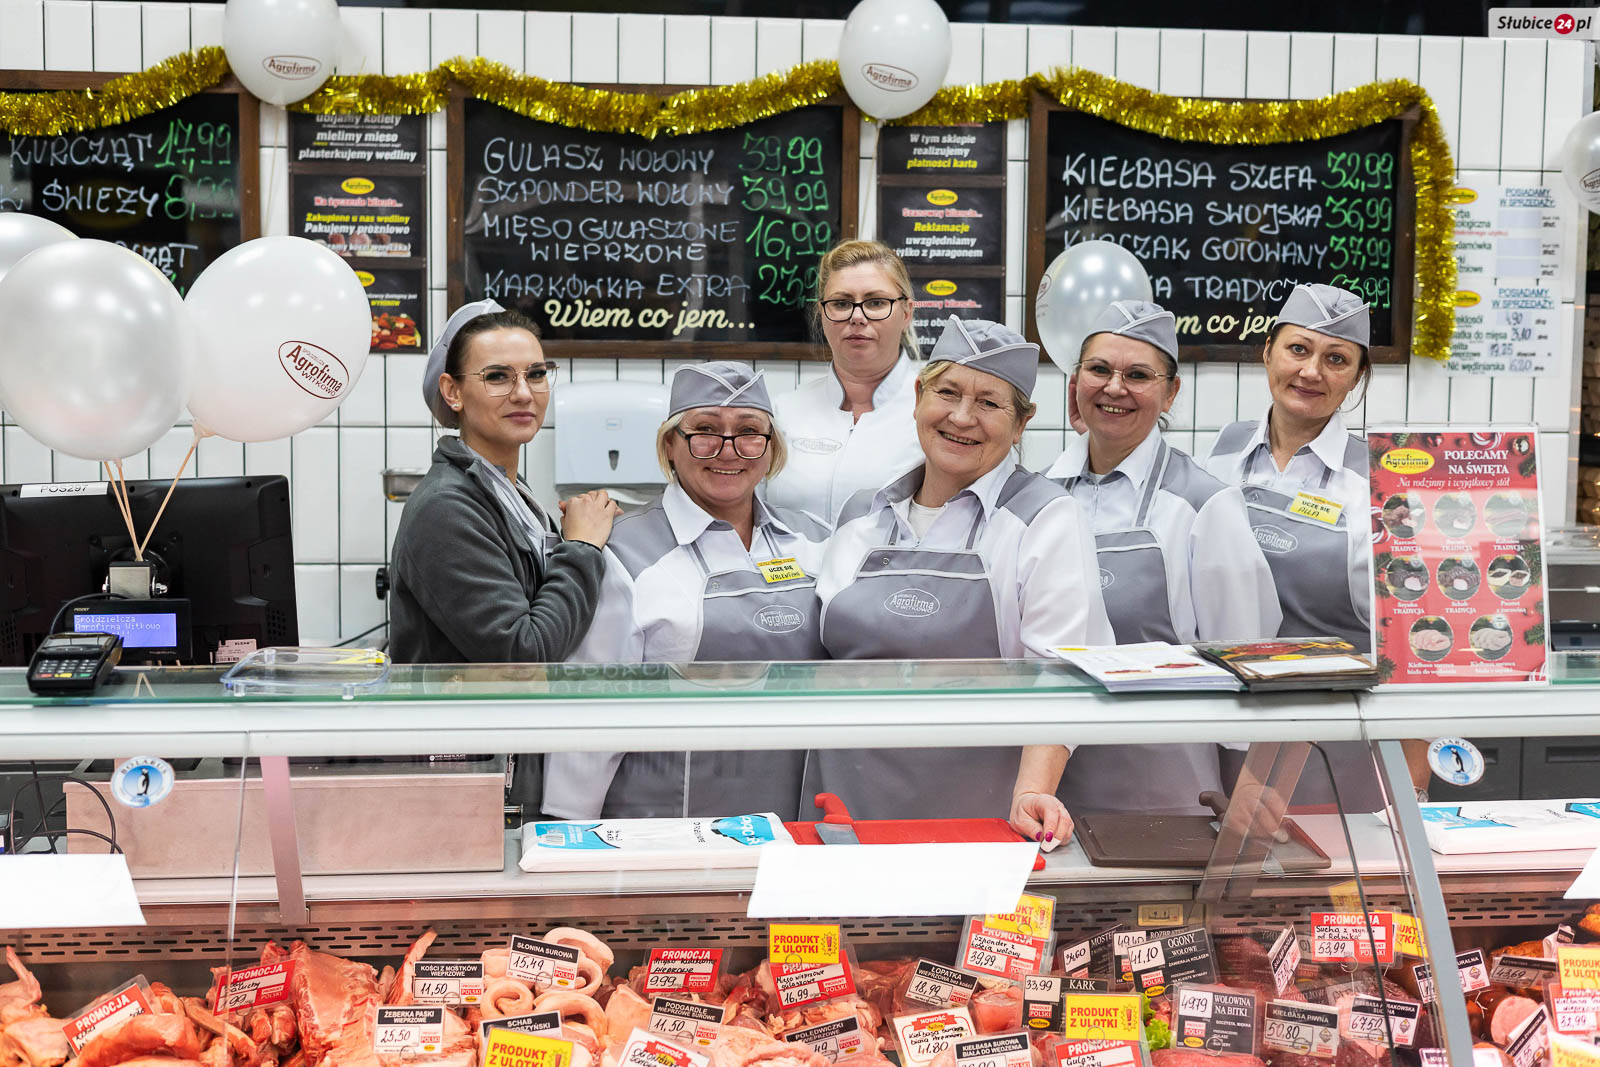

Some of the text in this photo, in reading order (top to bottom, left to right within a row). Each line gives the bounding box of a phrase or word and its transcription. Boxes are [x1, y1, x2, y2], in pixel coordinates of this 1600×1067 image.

[268, 57, 316, 74] Agrofirma
[867, 65, 912, 87] Agrofirma
[317, 131, 362, 143] mielimy
[921, 135, 939, 144] tym
[10, 119, 231, 173] KURCZĄT 17,99
[913, 146, 970, 157] realizujemy
[299, 148, 373, 161] plasterkujemy
[484, 132, 824, 176] GULASZ WOŁOWY 39,99
[1062, 151, 1394, 192] KIEŁBASA SZEFA 32,99
[477, 175, 829, 216] SZPONDER WOŁOWY 39,99
[1505, 188, 1551, 197] POSIADAMY
[1060, 194, 1393, 234] KIEŁBASA SWOJSKA 36,99
[304, 223, 356, 235] Pakujemy
[914, 223, 970, 234] Reklamacje
[483, 212, 833, 261] MIĘSO GULASZOWE 16,99
[531, 243, 707, 263] WIEPRZOWE
[929, 249, 983, 258] paragonem
[1202, 235, 1392, 270] GOTOWANY 37,99
[657, 273, 751, 302] EXTRA
[1499, 288, 1549, 298] POSIADAMY
[544, 300, 755, 335] Wiem co jem...
[1207, 314, 1240, 336] co
[285, 345, 343, 392] Agrofirma
[301, 370, 336, 397] WITKOWO
[1385, 454, 1428, 468] Agrofirma
[1444, 450, 1509, 460] POLECAMY
[1448, 462, 1509, 477] NA ŚWIĘTA
[1413, 478, 1445, 489] rodzinny
[891, 594, 935, 611] Agrofirma
[760, 610, 800, 626] Agrofirma
[1000, 913, 1031, 925] ULOTKI
[1316, 925, 1340, 933] Sucha
[774, 935, 820, 944] PRODUKT
[975, 935, 1007, 948] Szponder
[1168, 933, 1195, 948] OGONY
[517, 942, 573, 959] SŁONINA SUROWA
[662, 950, 711, 960] PROMOCJA
[774, 945, 818, 954] Z ULOTKI
[1171, 945, 1198, 957] WOŁOWE
[1318, 942, 1346, 956] 53,99
[513, 956, 545, 970] 15,49
[970, 951, 996, 967] 39,99
[231, 964, 283, 982] PROMOCJA
[446, 964, 478, 972] MOSTKÓW
[931, 966, 962, 980] ŁOPATKA
[554, 970, 575, 980] POLSKI
[650, 976, 677, 988] 9,99
[825, 978, 845, 987] PRODUKT
[825, 984, 847, 993] POLSKI
[1026, 979, 1096, 991] 33,99 KARK
[1142, 977, 1164, 987] POLSKI
[420, 983, 448, 996] 11,50
[915, 981, 941, 997] 18,99
[785, 988, 809, 1004] 16,99
[1214, 994, 1251, 1006] WOŁOWINA
[75, 994, 131, 1031] PROMOCJA
[384, 1010, 435, 1018] ŻEBERKA PASKI
[658, 1006, 690, 1017] WIEPRZOWE
[666, 1002, 708, 1014] PODGARDLE
[1071, 1008, 1119, 1017] PRODUKT
[1215, 1005, 1248, 1016] NA BITKI
[507, 1018, 533, 1027] SCHAB
[920, 1015, 946, 1024] NOWOŚĆ
[1070, 1018, 1118, 1028] Z ULOTKI
[1273, 1009, 1329, 1024] KIEŁBASA PIWNA
[654, 1018, 685, 1032] 11,50
[795, 1023, 844, 1040] POLĘDWICZKI
[1266, 1022, 1300, 1040] 50,80
[381, 1029, 411, 1043] 25,50
[696, 1031, 717, 1039] POLSKI
[840, 1040, 860, 1049] POLSKI
[962, 1038, 1019, 1051] KIEŁBASA SUROWA
[962, 1049, 980, 1058] BIAŁA
[992, 1044, 1023, 1054] WĘDZENIA
[492, 1043, 547, 1061] PRODUKT
[489, 1055, 544, 1067] Z ULOTKI
